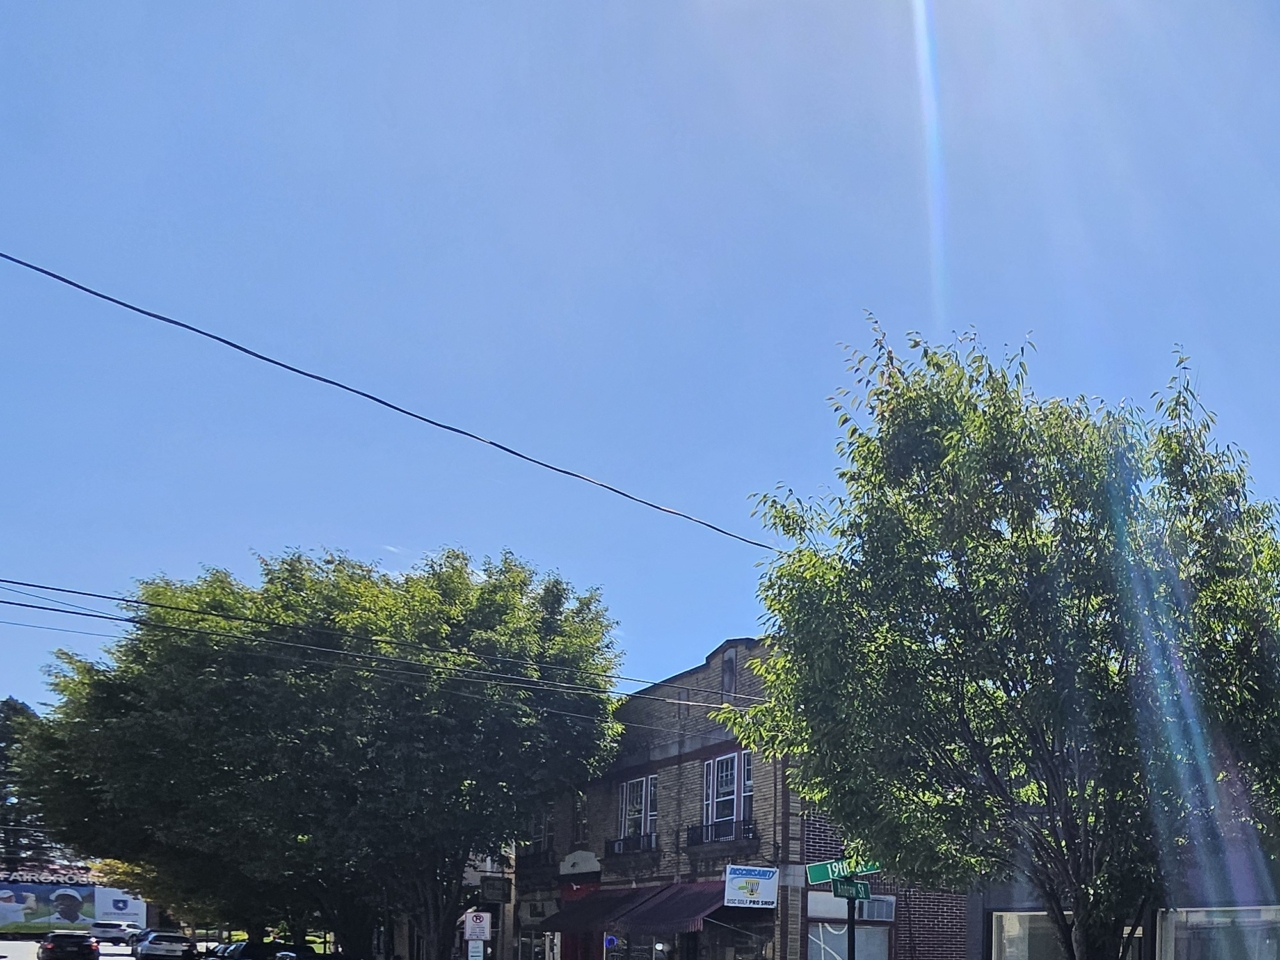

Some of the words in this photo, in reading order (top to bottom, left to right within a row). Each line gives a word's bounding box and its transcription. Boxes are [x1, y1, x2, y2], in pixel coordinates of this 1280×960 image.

[826, 860, 850, 879] 19th
[858, 883, 866, 898] St
[749, 899, 760, 907] PRO
